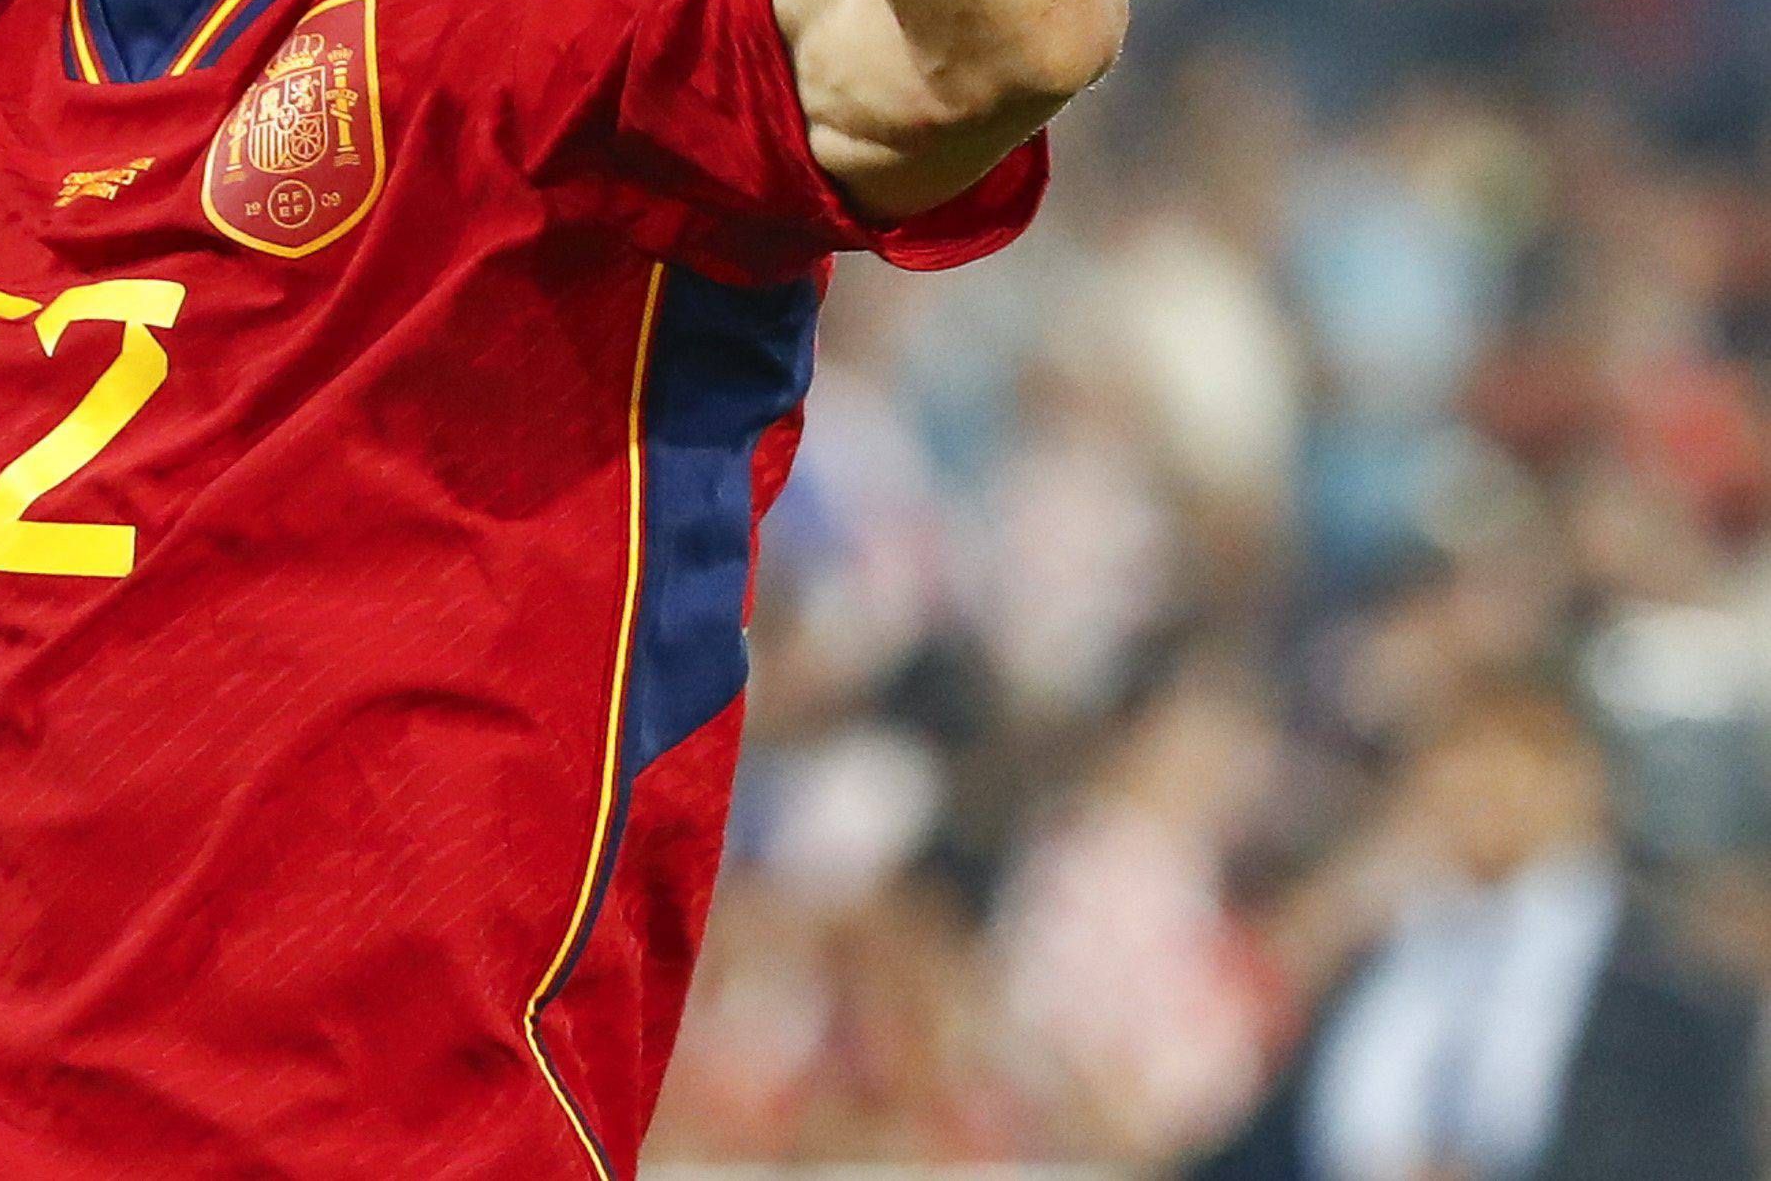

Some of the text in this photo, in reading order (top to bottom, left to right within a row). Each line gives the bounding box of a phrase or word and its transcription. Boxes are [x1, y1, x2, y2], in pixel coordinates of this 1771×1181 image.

[278, 190, 303, 204] RF
[321, 191, 342, 207] 09
[244, 201, 262, 216] 19
[279, 204, 304, 217] EF
